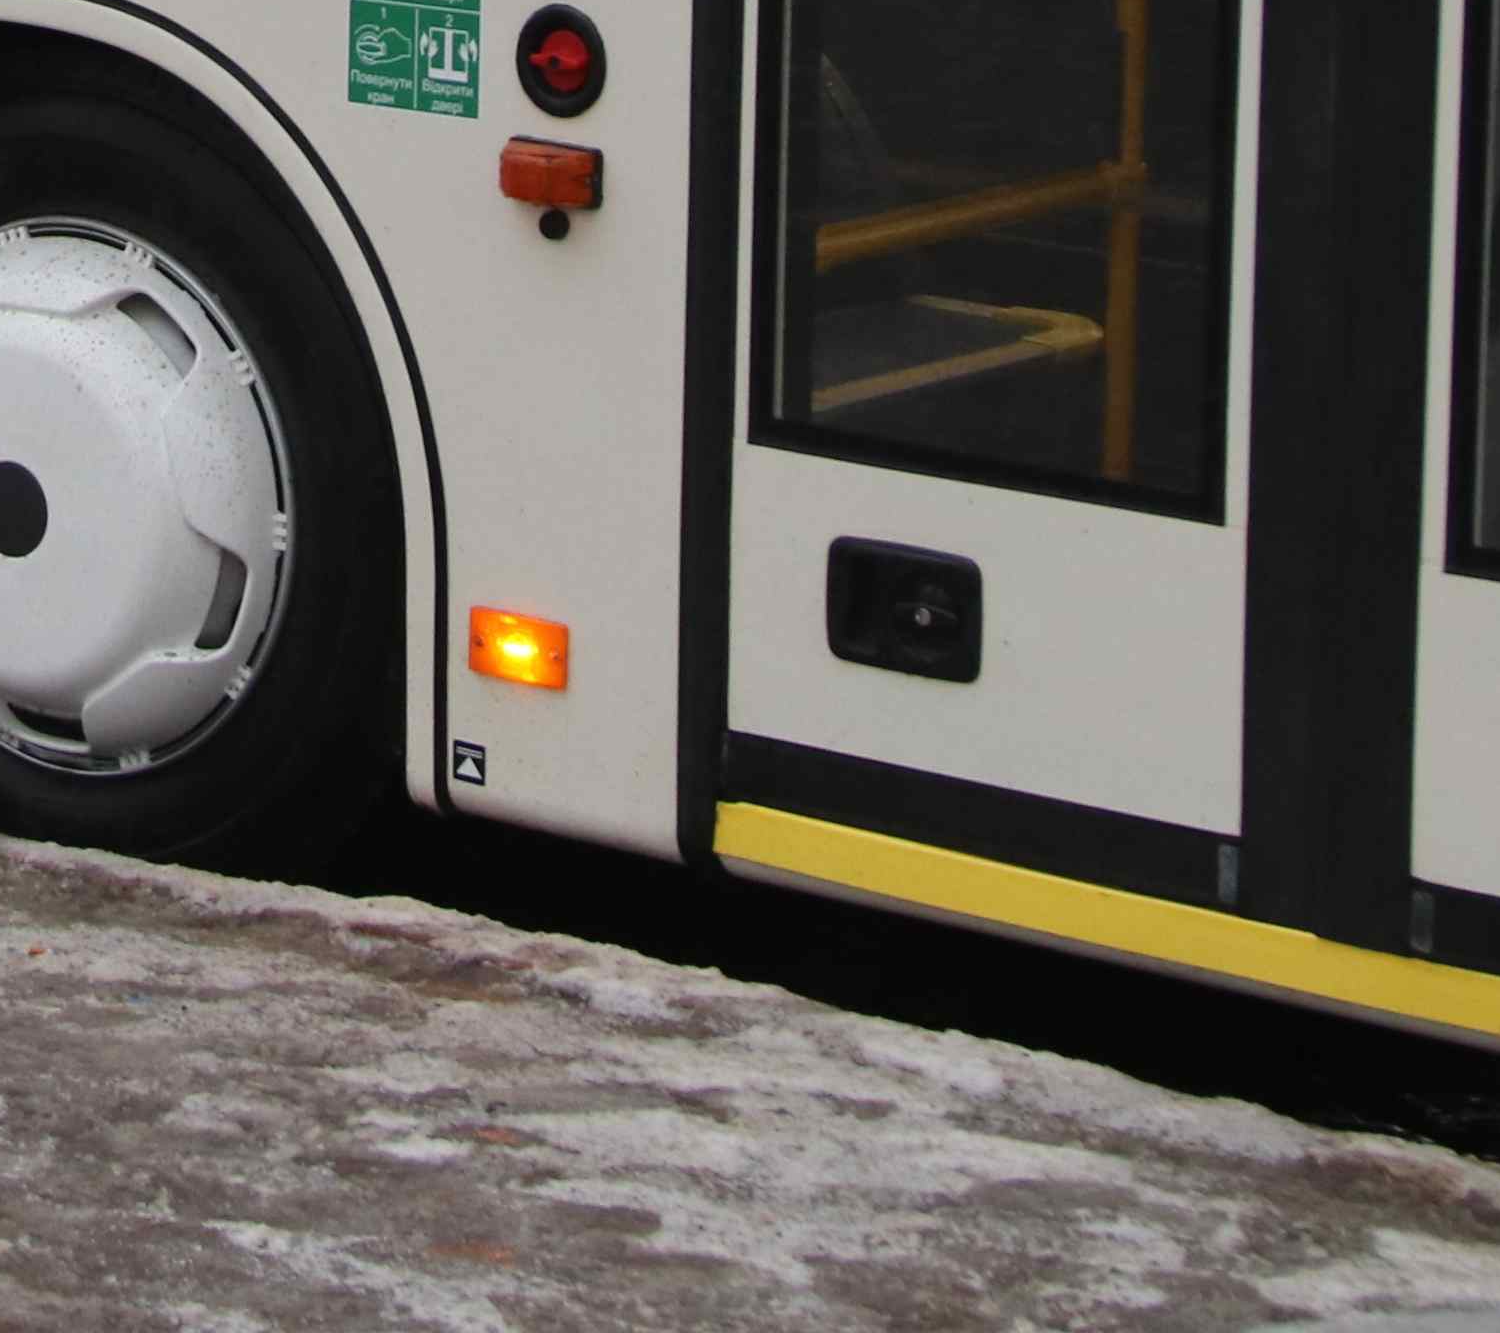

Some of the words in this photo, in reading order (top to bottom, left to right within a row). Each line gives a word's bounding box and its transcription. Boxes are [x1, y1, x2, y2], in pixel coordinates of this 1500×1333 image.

[381, 6, 387, 19] 1
[445, 14, 454, 27] 2
[350, 69, 413, 90] Повернути
[422, 79, 474, 97] Відкрити
[431, 100, 464, 114] двері
